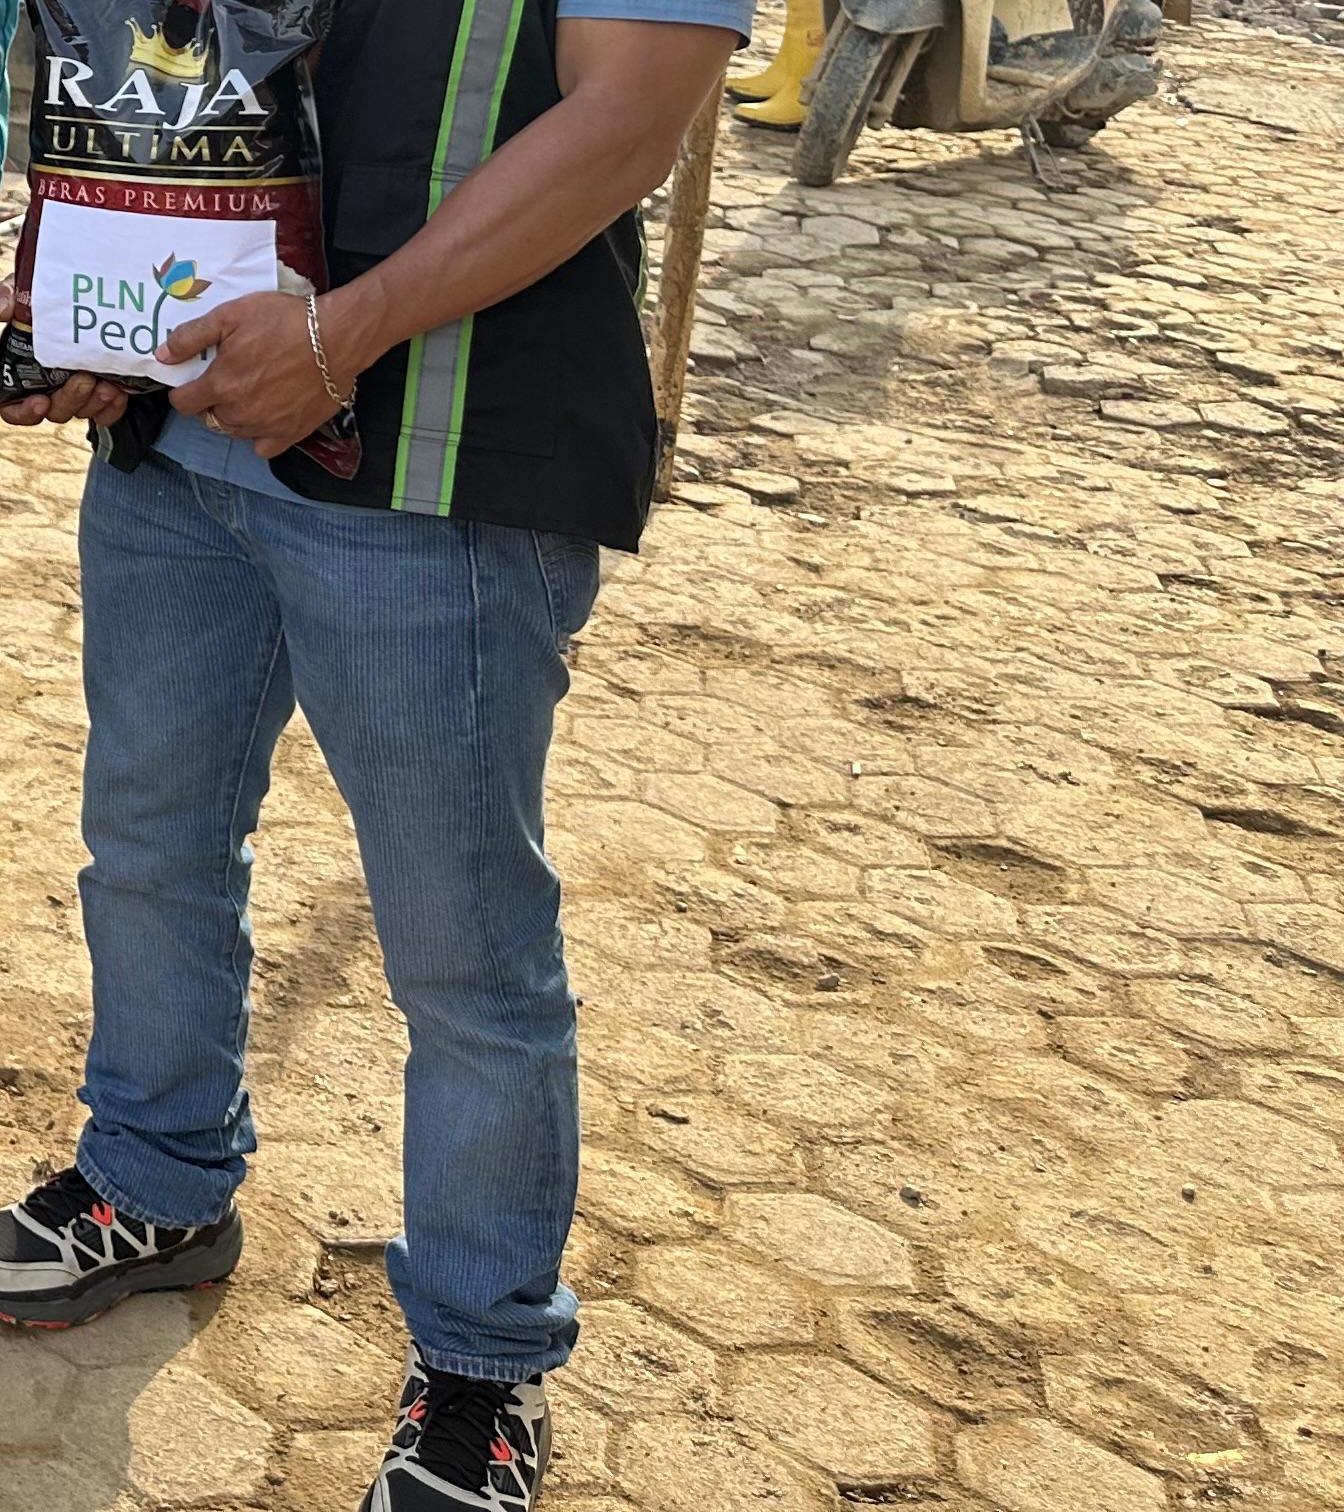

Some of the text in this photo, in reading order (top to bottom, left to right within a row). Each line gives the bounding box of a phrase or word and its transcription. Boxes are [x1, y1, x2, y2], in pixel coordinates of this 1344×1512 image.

[44, 56, 269, 130] RAJA
[52, 125, 253, 162] ULTIMA
[38, 178, 274, 213] BERAS PREMIUM
[73, 273, 144, 313] PLN
[2, 364, 14, 387] 5
